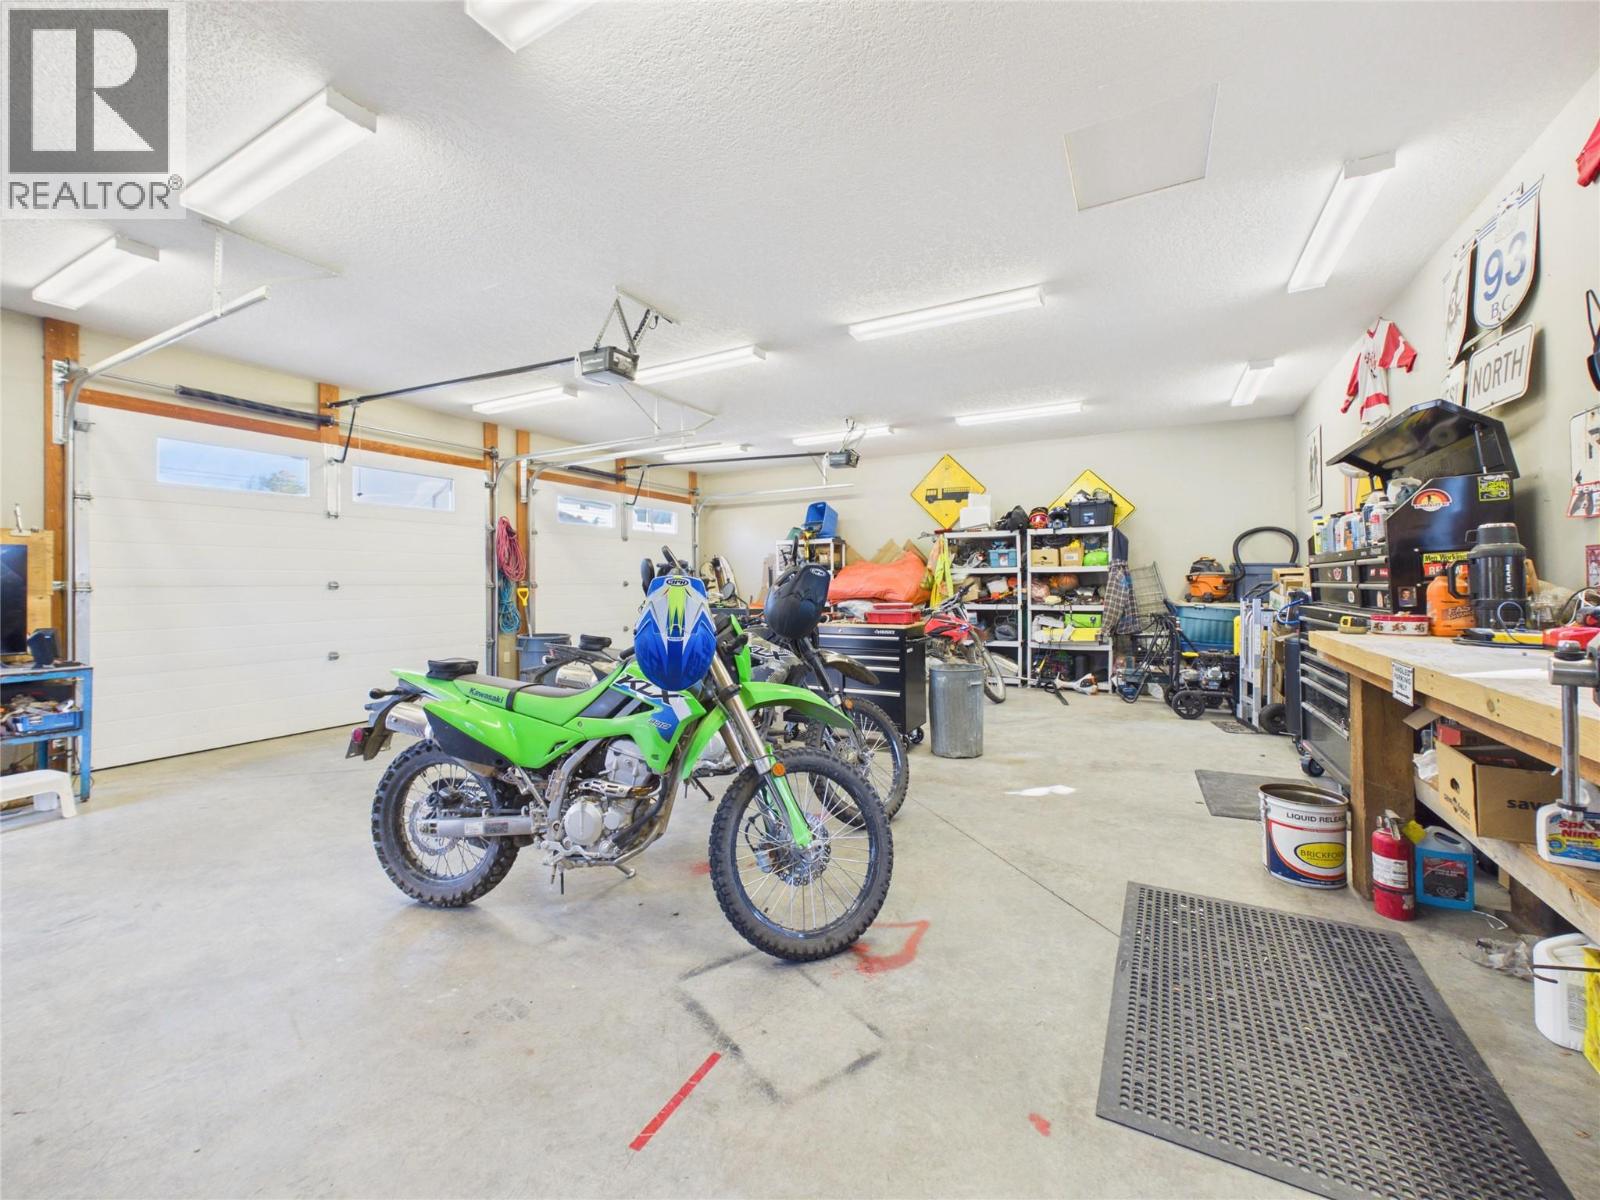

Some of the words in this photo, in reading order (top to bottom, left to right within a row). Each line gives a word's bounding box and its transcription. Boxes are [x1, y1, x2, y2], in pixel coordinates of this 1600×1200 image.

[1483, 231, 1527, 301] 93
[1472, 345, 1525, 399] NORTH
[469, 687, 505, 704] Kawasaki
[1506, 799, 1545, 811] sav
[1286, 812, 1317, 823] LIQUID
[1558, 820, 1585, 830] Spr
[1561, 828, 1599, 840] Nine
